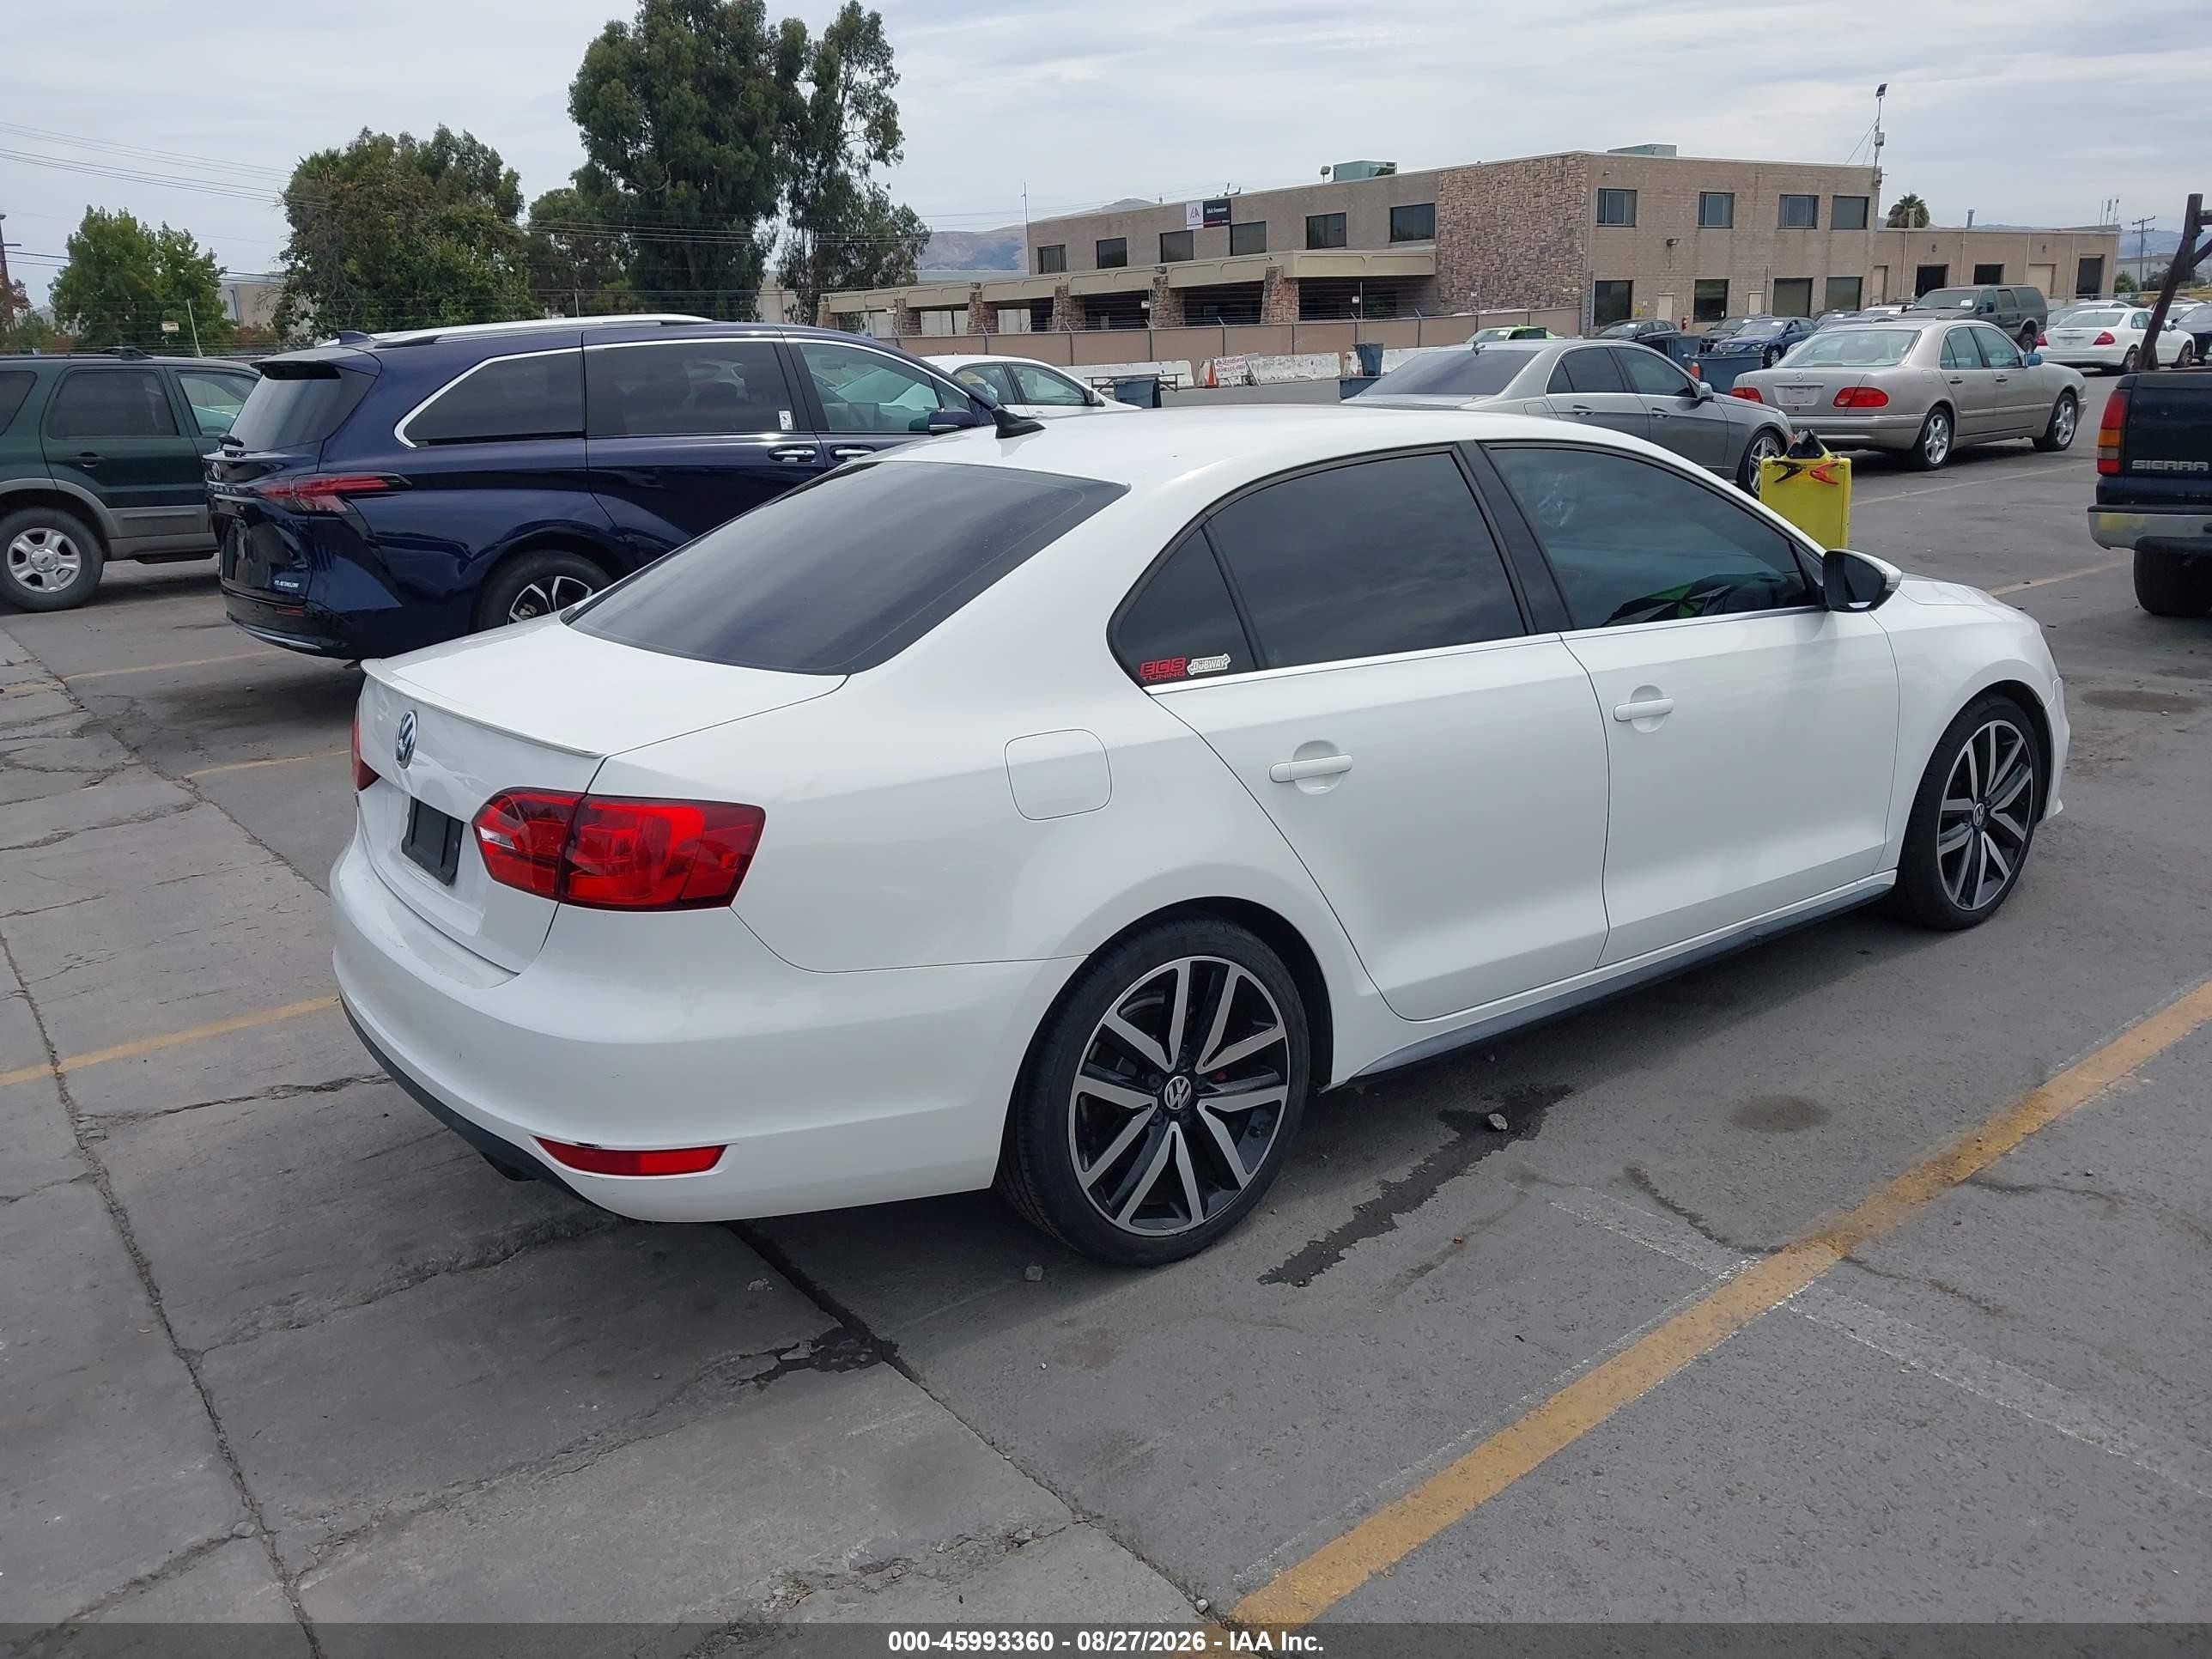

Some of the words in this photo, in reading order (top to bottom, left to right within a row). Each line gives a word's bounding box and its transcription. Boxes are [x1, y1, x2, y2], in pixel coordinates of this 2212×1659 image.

[2131, 459, 2209, 471] SIERRA
[1140, 658, 1186, 677] ECS
[1141, 672, 1186, 681] TUNING
